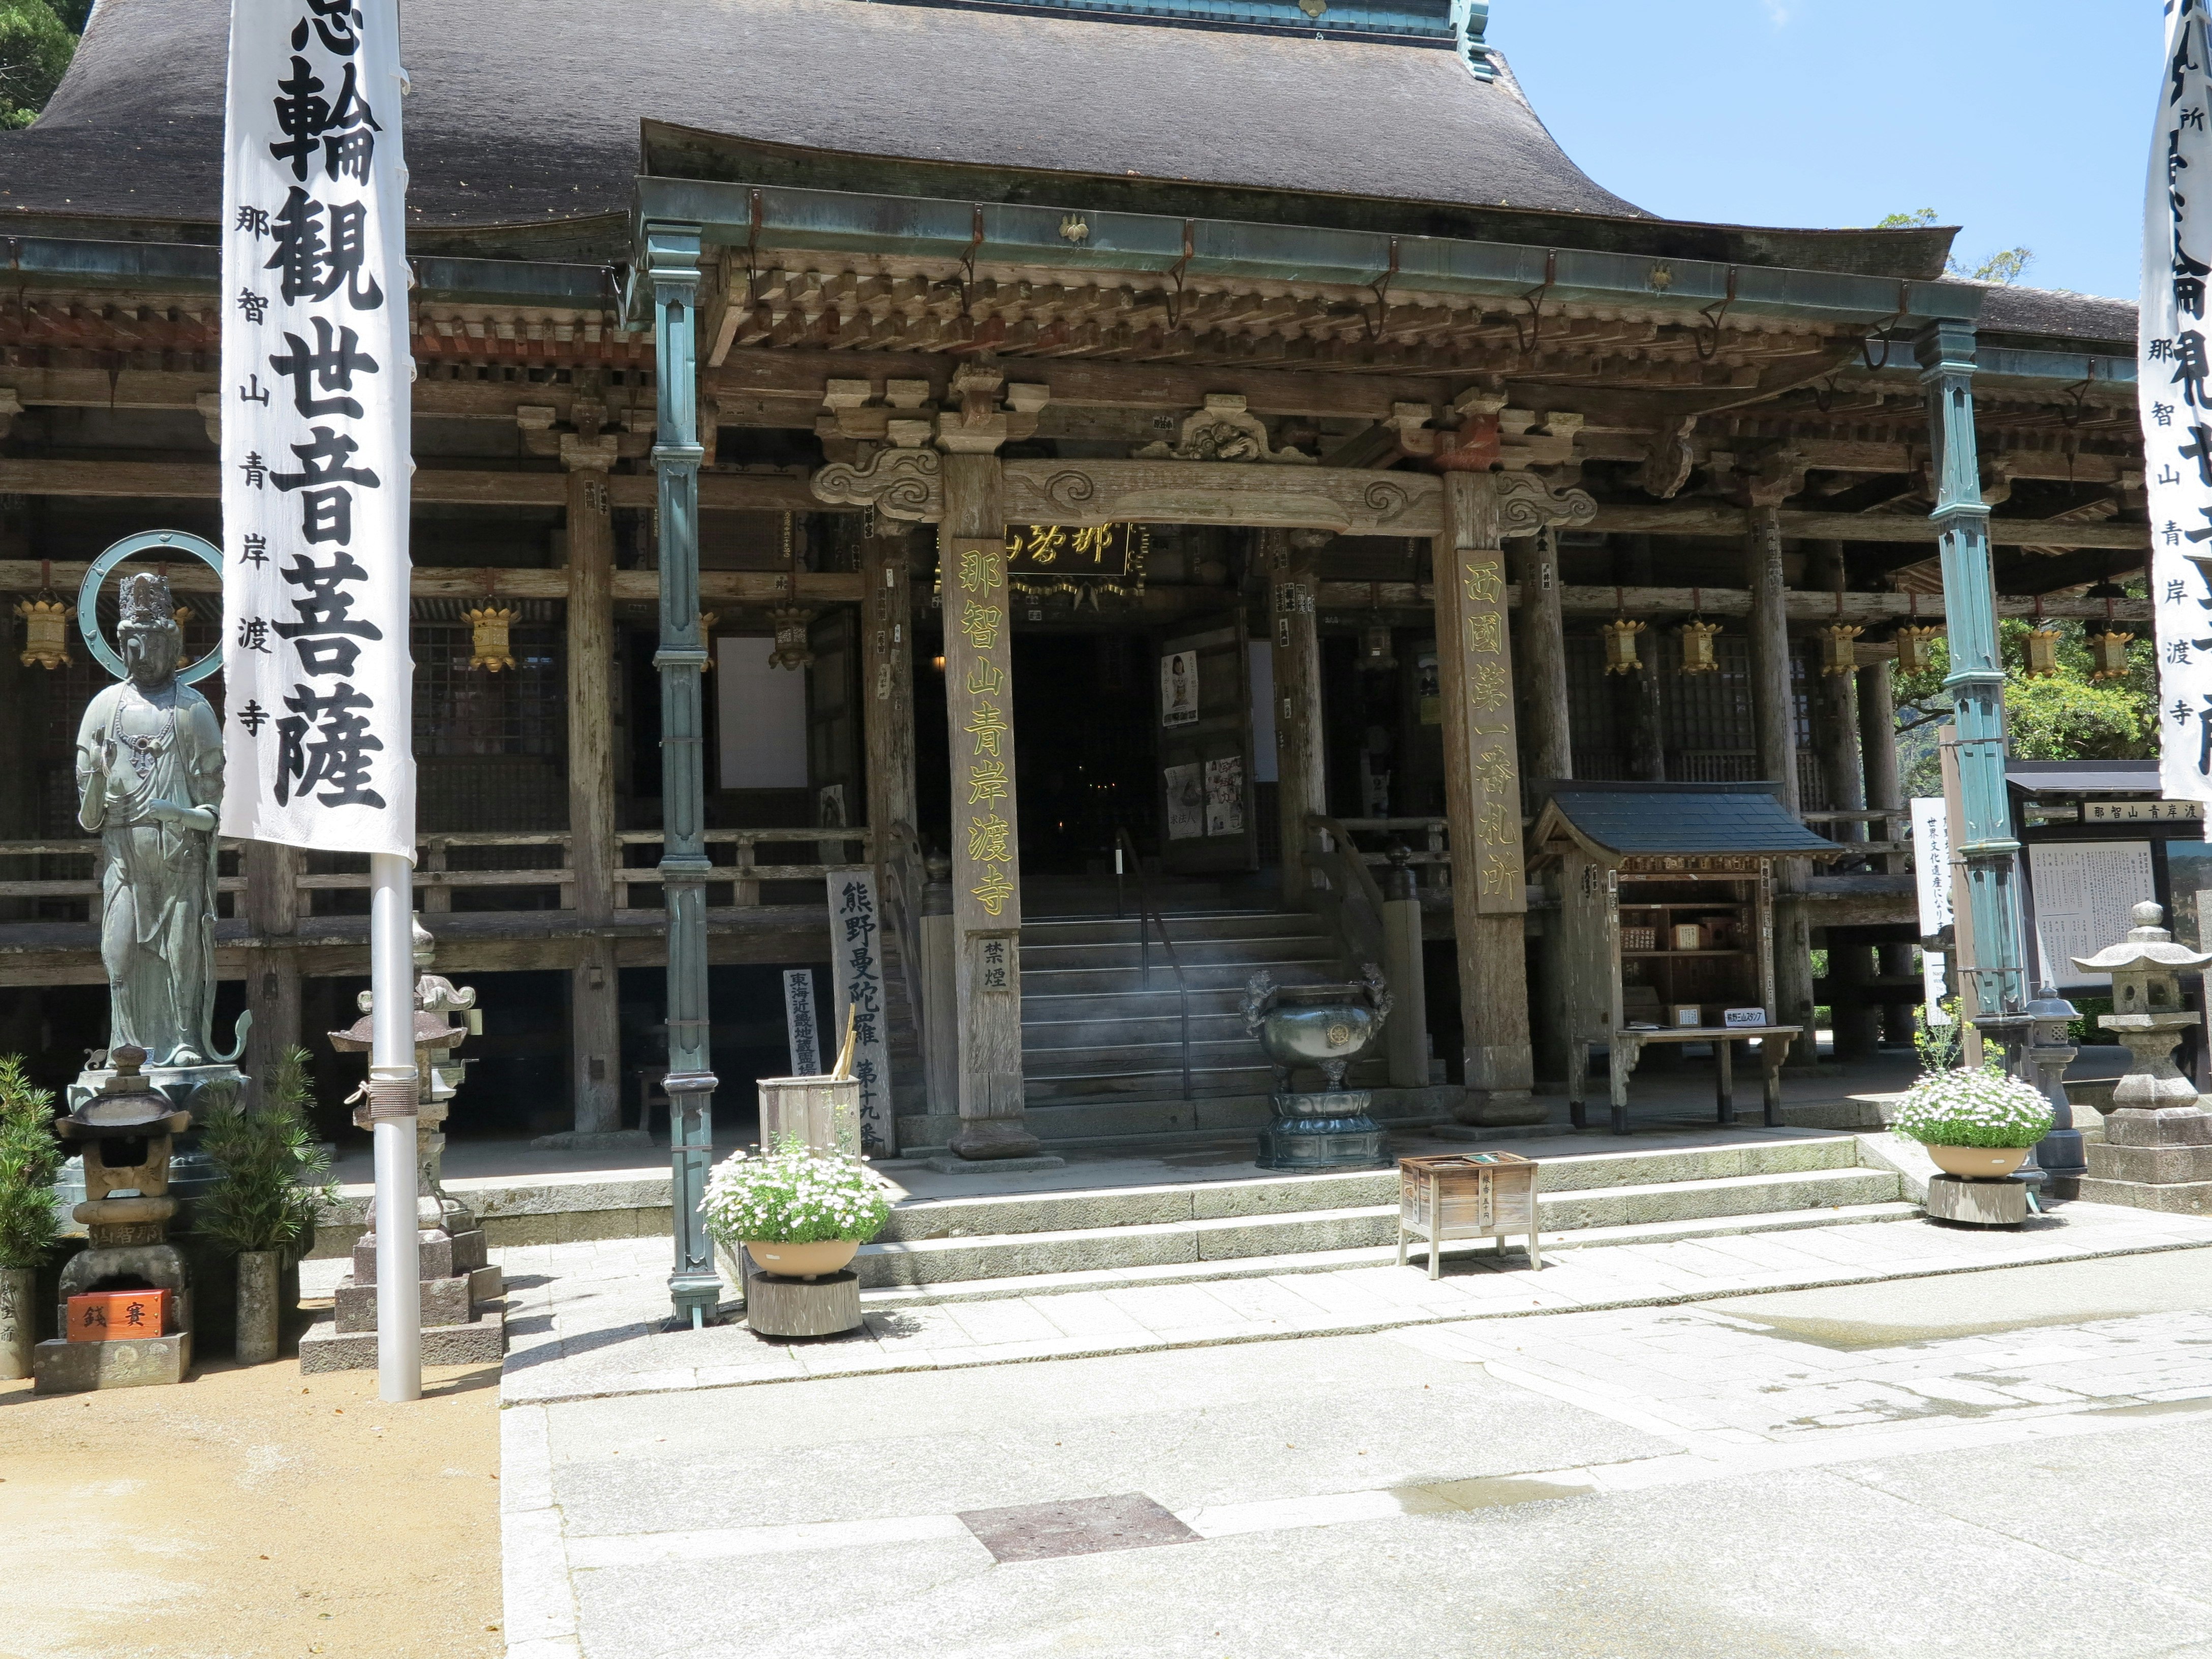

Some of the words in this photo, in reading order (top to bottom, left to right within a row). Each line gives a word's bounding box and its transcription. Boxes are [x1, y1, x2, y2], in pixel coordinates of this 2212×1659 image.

[235, 205, 272, 737] 那智山青岸渡寺
[2147, 339, 2193, 726] 那智山青岸渡寺
[959, 549, 1015, 915] 那智山青岸渡寺
[2094, 804, 2204, 819] 那智山青岸渡
[984, 942, 1007, 988] 禁煙
